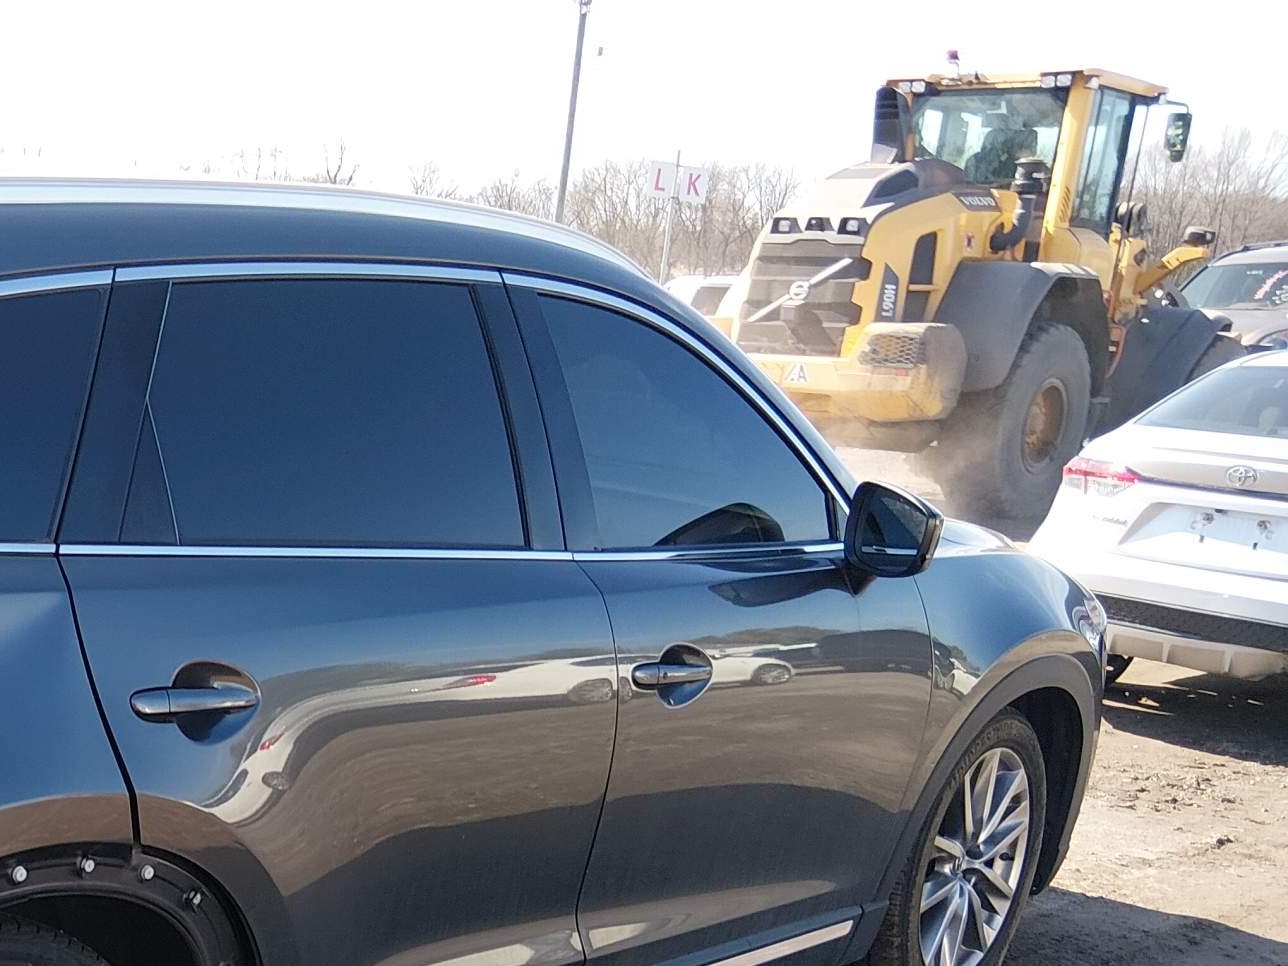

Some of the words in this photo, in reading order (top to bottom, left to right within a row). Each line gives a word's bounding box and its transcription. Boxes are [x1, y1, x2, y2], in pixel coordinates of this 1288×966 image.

[654, 167, 665, 192] L
[686, 172, 702, 197] K
[959, 196, 997, 207] VOLVO
